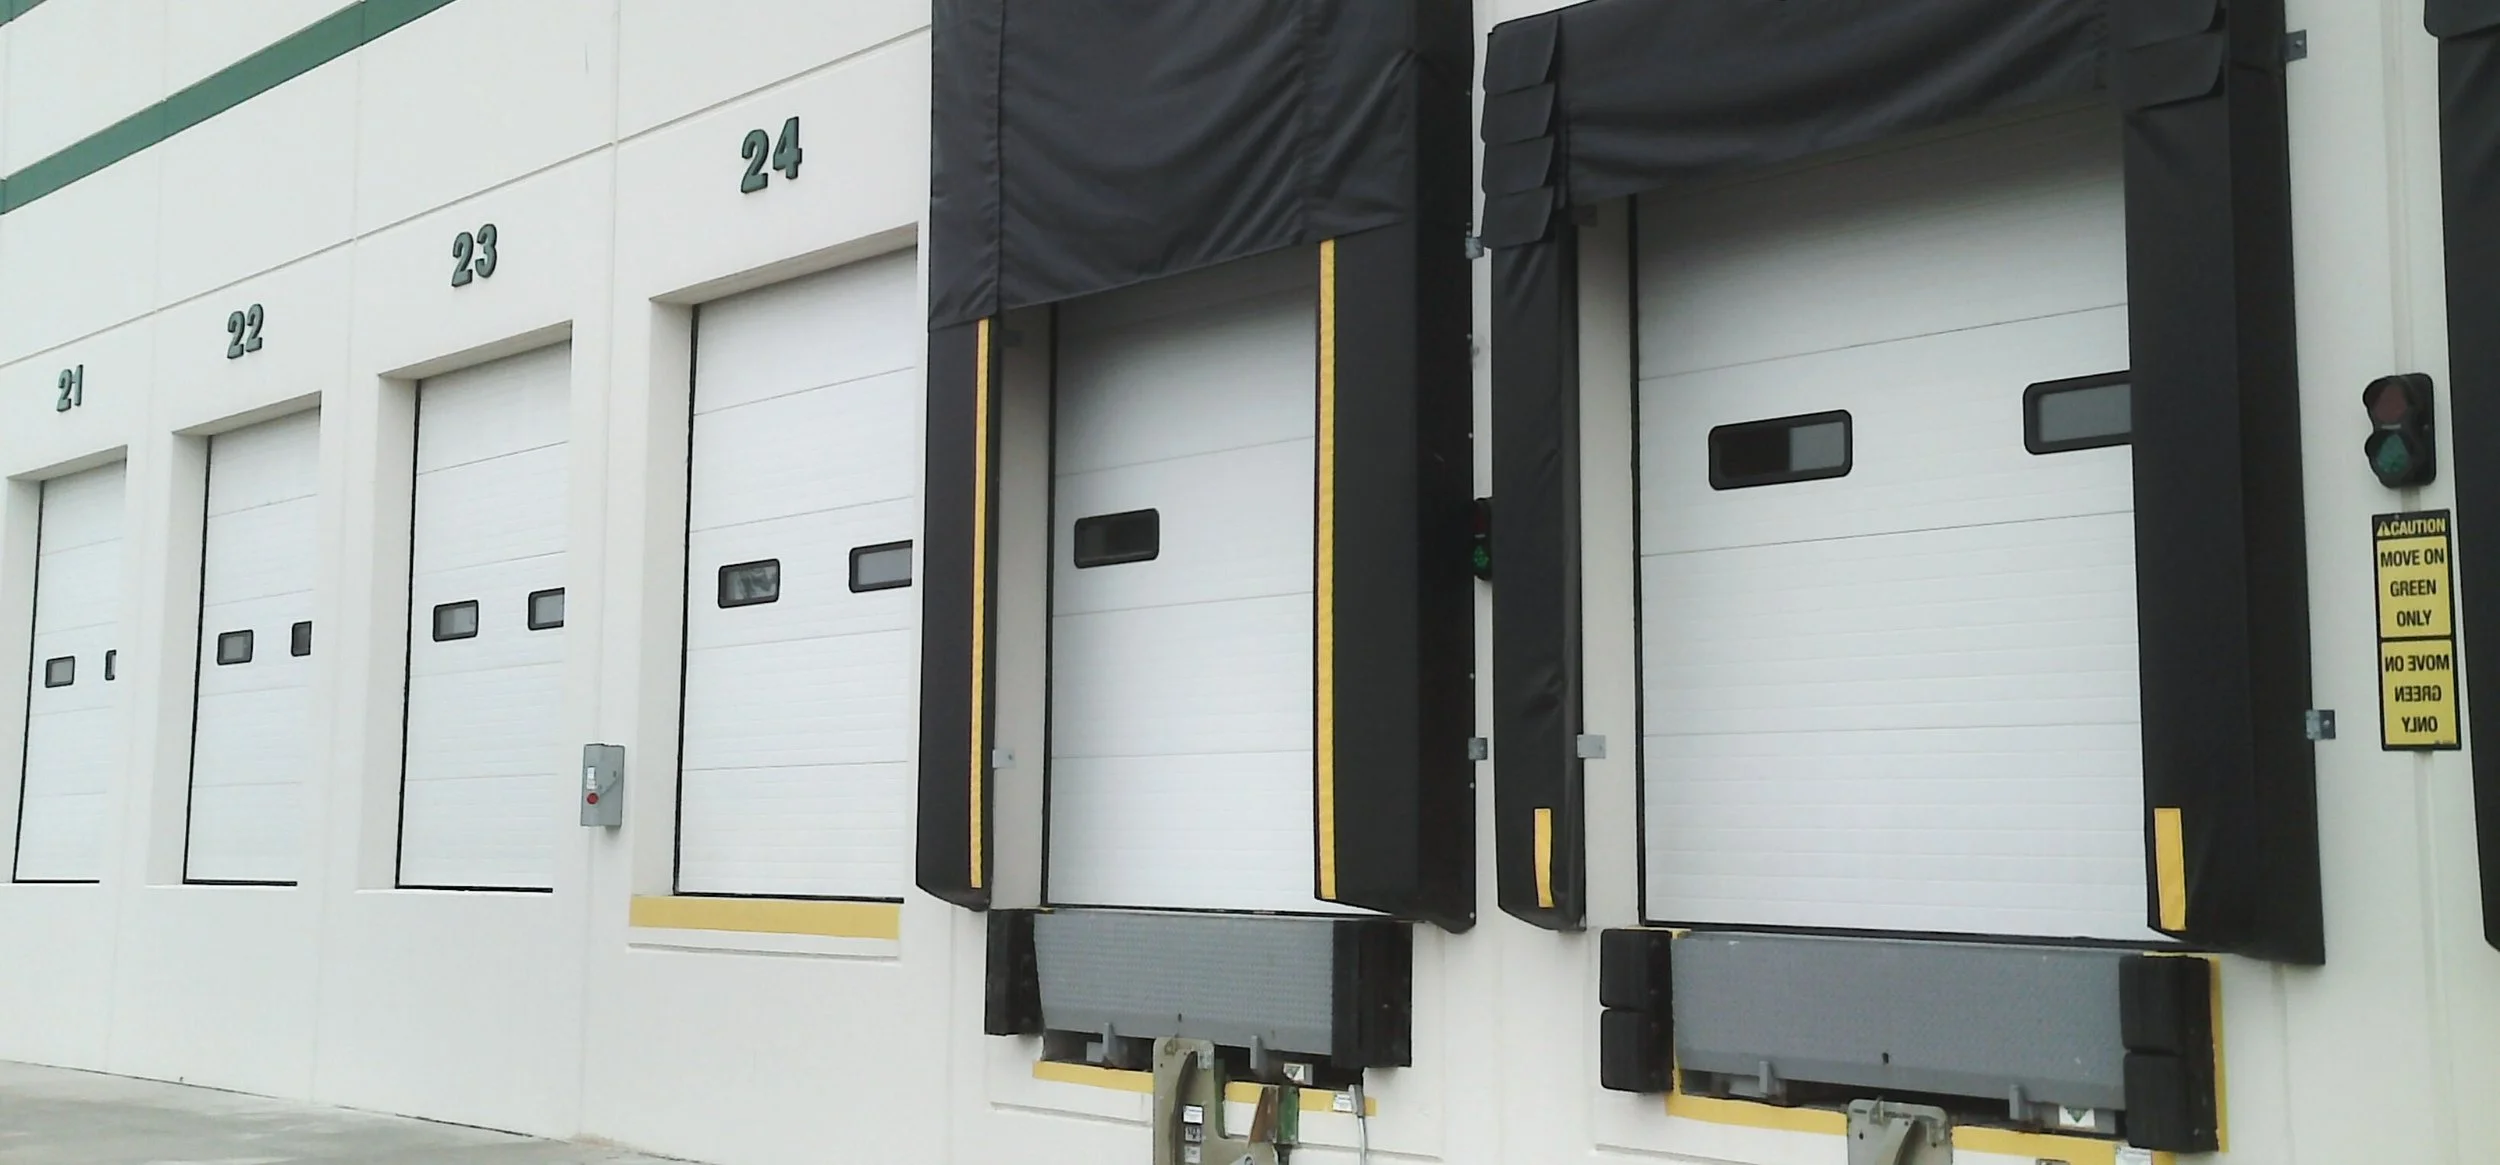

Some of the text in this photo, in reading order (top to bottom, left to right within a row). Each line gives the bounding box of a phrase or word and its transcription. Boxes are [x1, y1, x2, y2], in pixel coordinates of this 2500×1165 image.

[740, 116, 803, 194] 24
[451, 223, 498, 287] 23
[227, 303, 265, 359] 22
[56, 364, 84, 412] 21
[2390, 518, 2446, 536] CAUTION
[2380, 548, 2444, 567] MOVE ON
[2390, 579, 2437, 597] GREEN
[2396, 610, 2432, 627] ONLY
